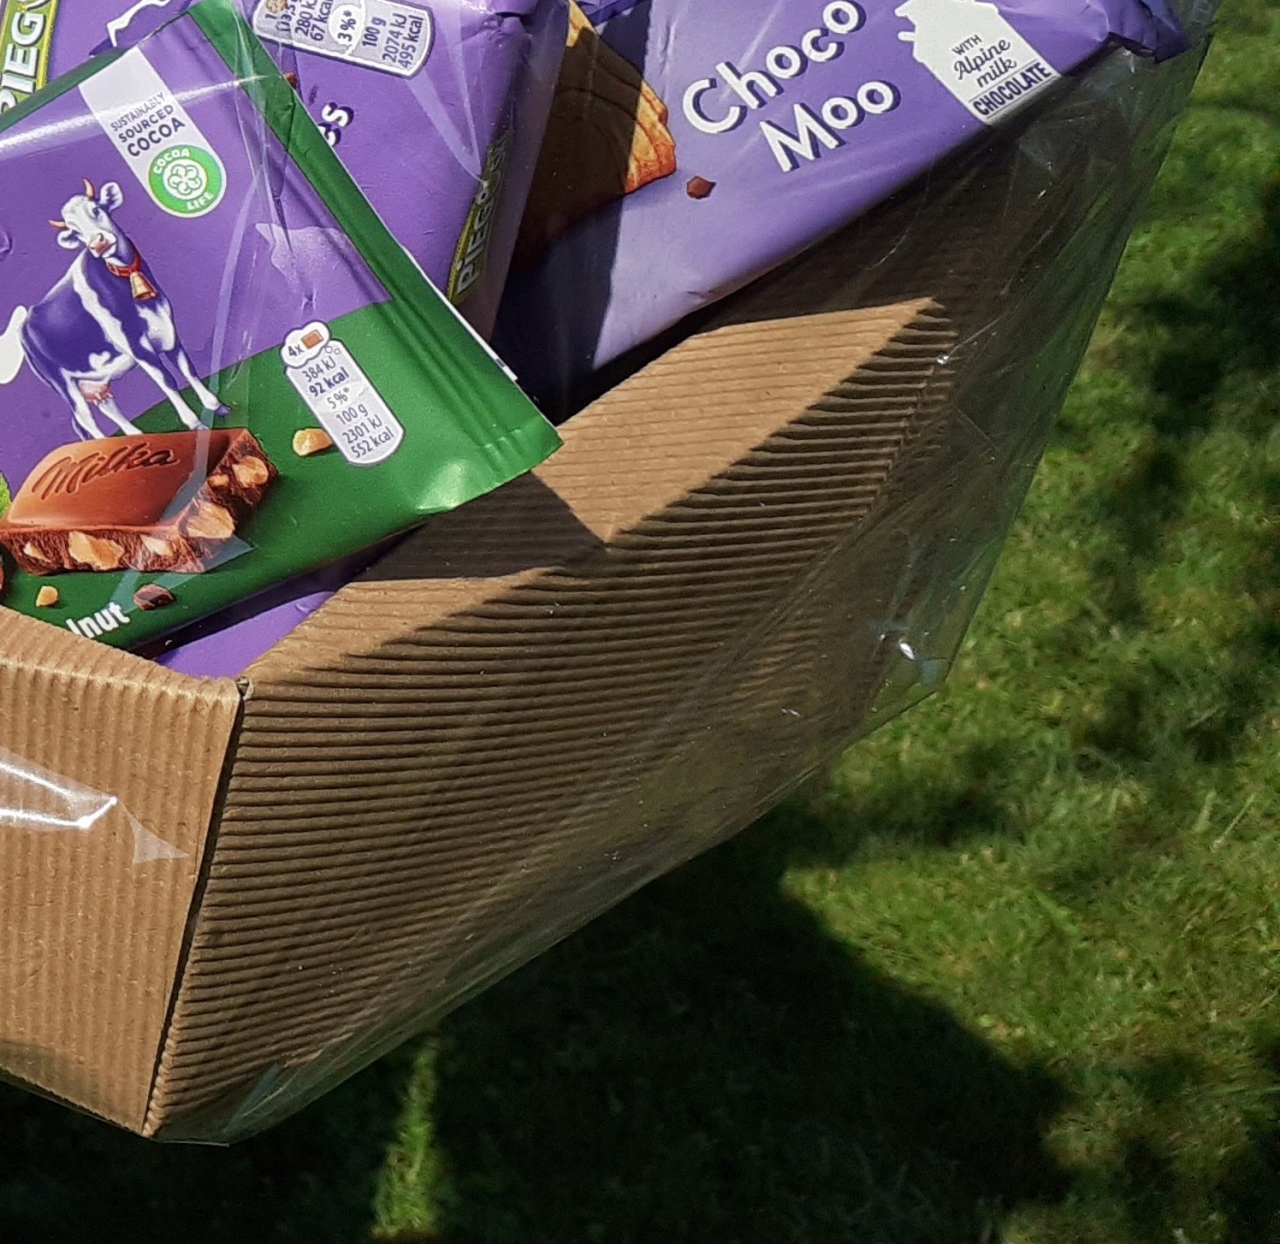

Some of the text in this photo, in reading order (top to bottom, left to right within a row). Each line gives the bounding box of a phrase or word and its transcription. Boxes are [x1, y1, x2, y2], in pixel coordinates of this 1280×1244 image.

[295, 11, 312, 37] 280
[310, 23, 326, 42] 67
[362, 26, 381, 48] 100
[382, 13, 407, 63] 2074 kJ
[398, 15, 424, 69] 495 kcal
[952, 34, 983, 56] WITH
[682, 0, 867, 135] Choco
[953, 39, 1011, 80] Alpine
[976, 57, 1018, 88] milk
[972, 62, 1053, 116] CHOCOLATE
[110, 92, 166, 132] SUSTAINABLY
[118, 105, 175, 143] SOURCED
[759, 79, 902, 173] Moo
[127, 117, 186, 157] COCOA
[153, 148, 190, 174] COCOA
[186, 191, 214, 211] LIFE
[302, 355, 337, 383] 384 kJ
[309, 366, 350, 397] 92 kcal
[336, 404, 369, 425] 100 g
[342, 414, 383, 444] 2301 kJ
[351, 426, 395, 459] 552 kcal
[31, 442, 181, 500] Milka
